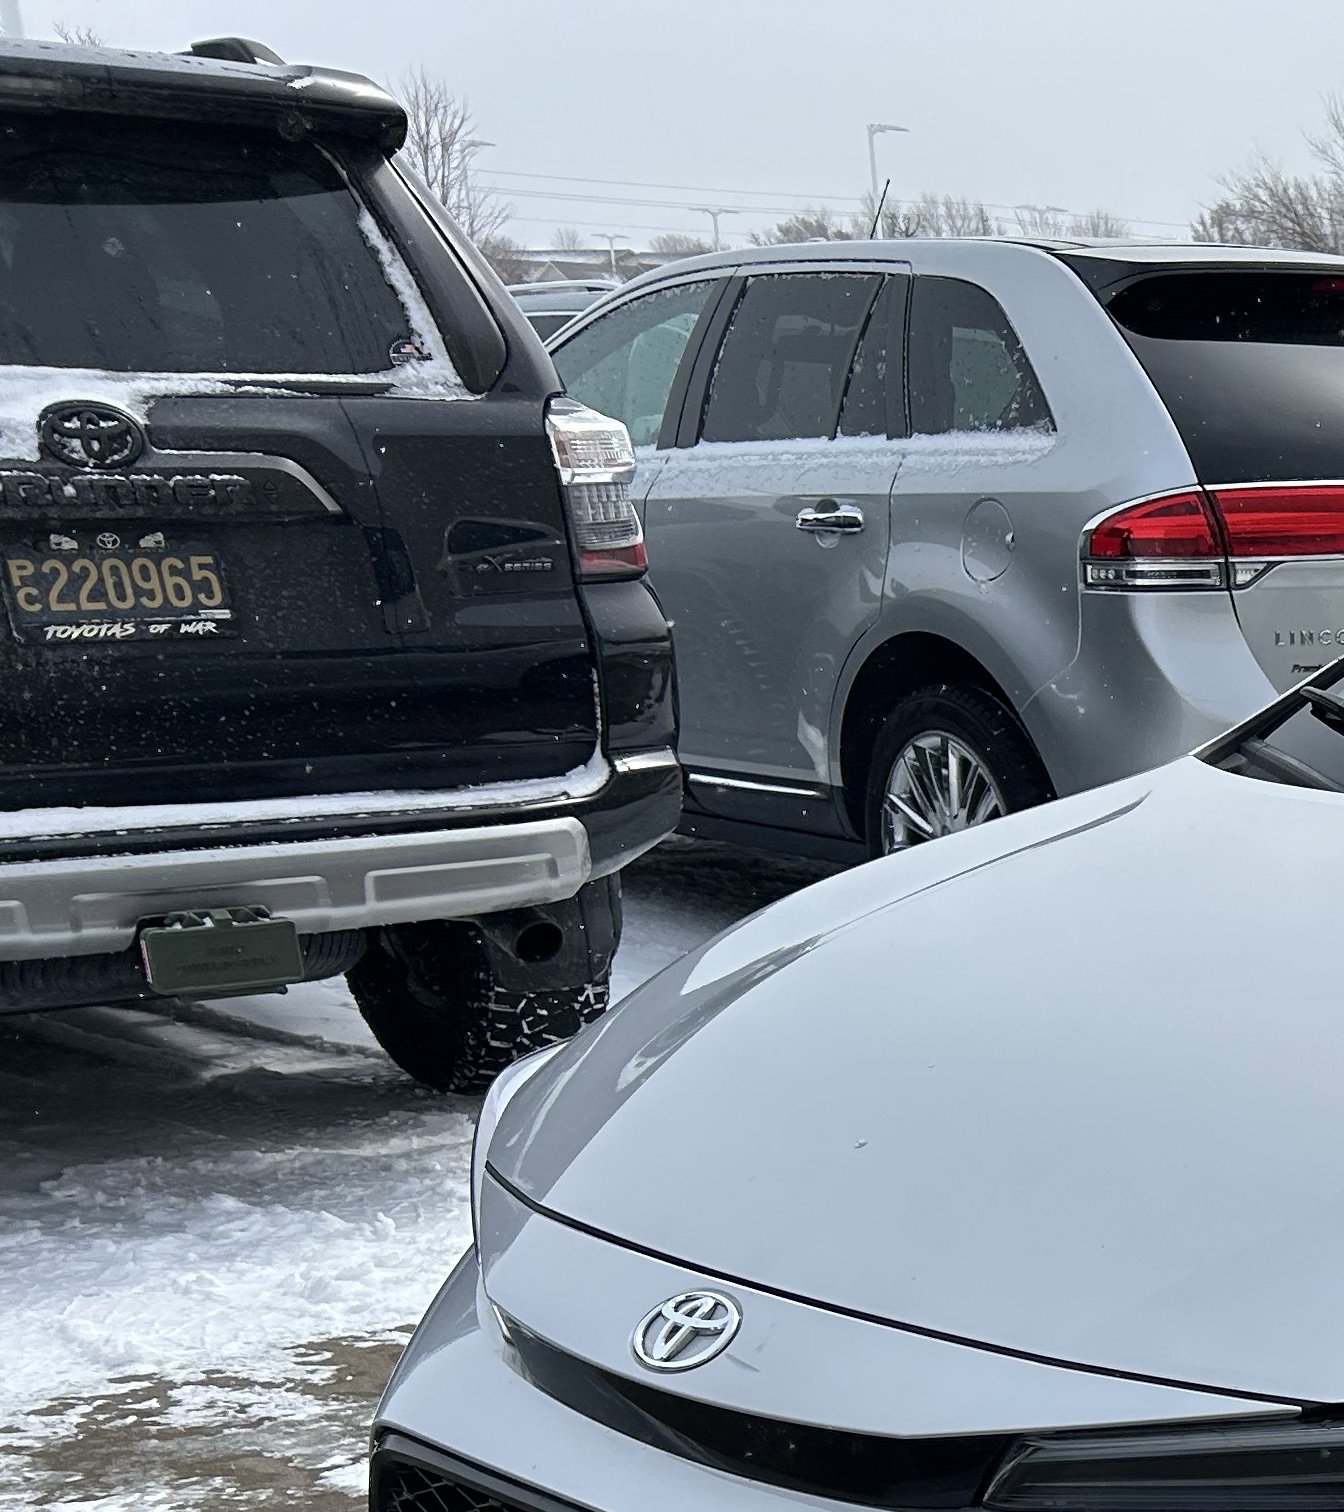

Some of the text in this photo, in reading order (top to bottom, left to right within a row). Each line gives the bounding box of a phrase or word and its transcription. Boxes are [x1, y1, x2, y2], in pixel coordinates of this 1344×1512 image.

[41, 555, 223, 612] 220965
[43, 621, 219, 641] TOYOTAS OF WAR
